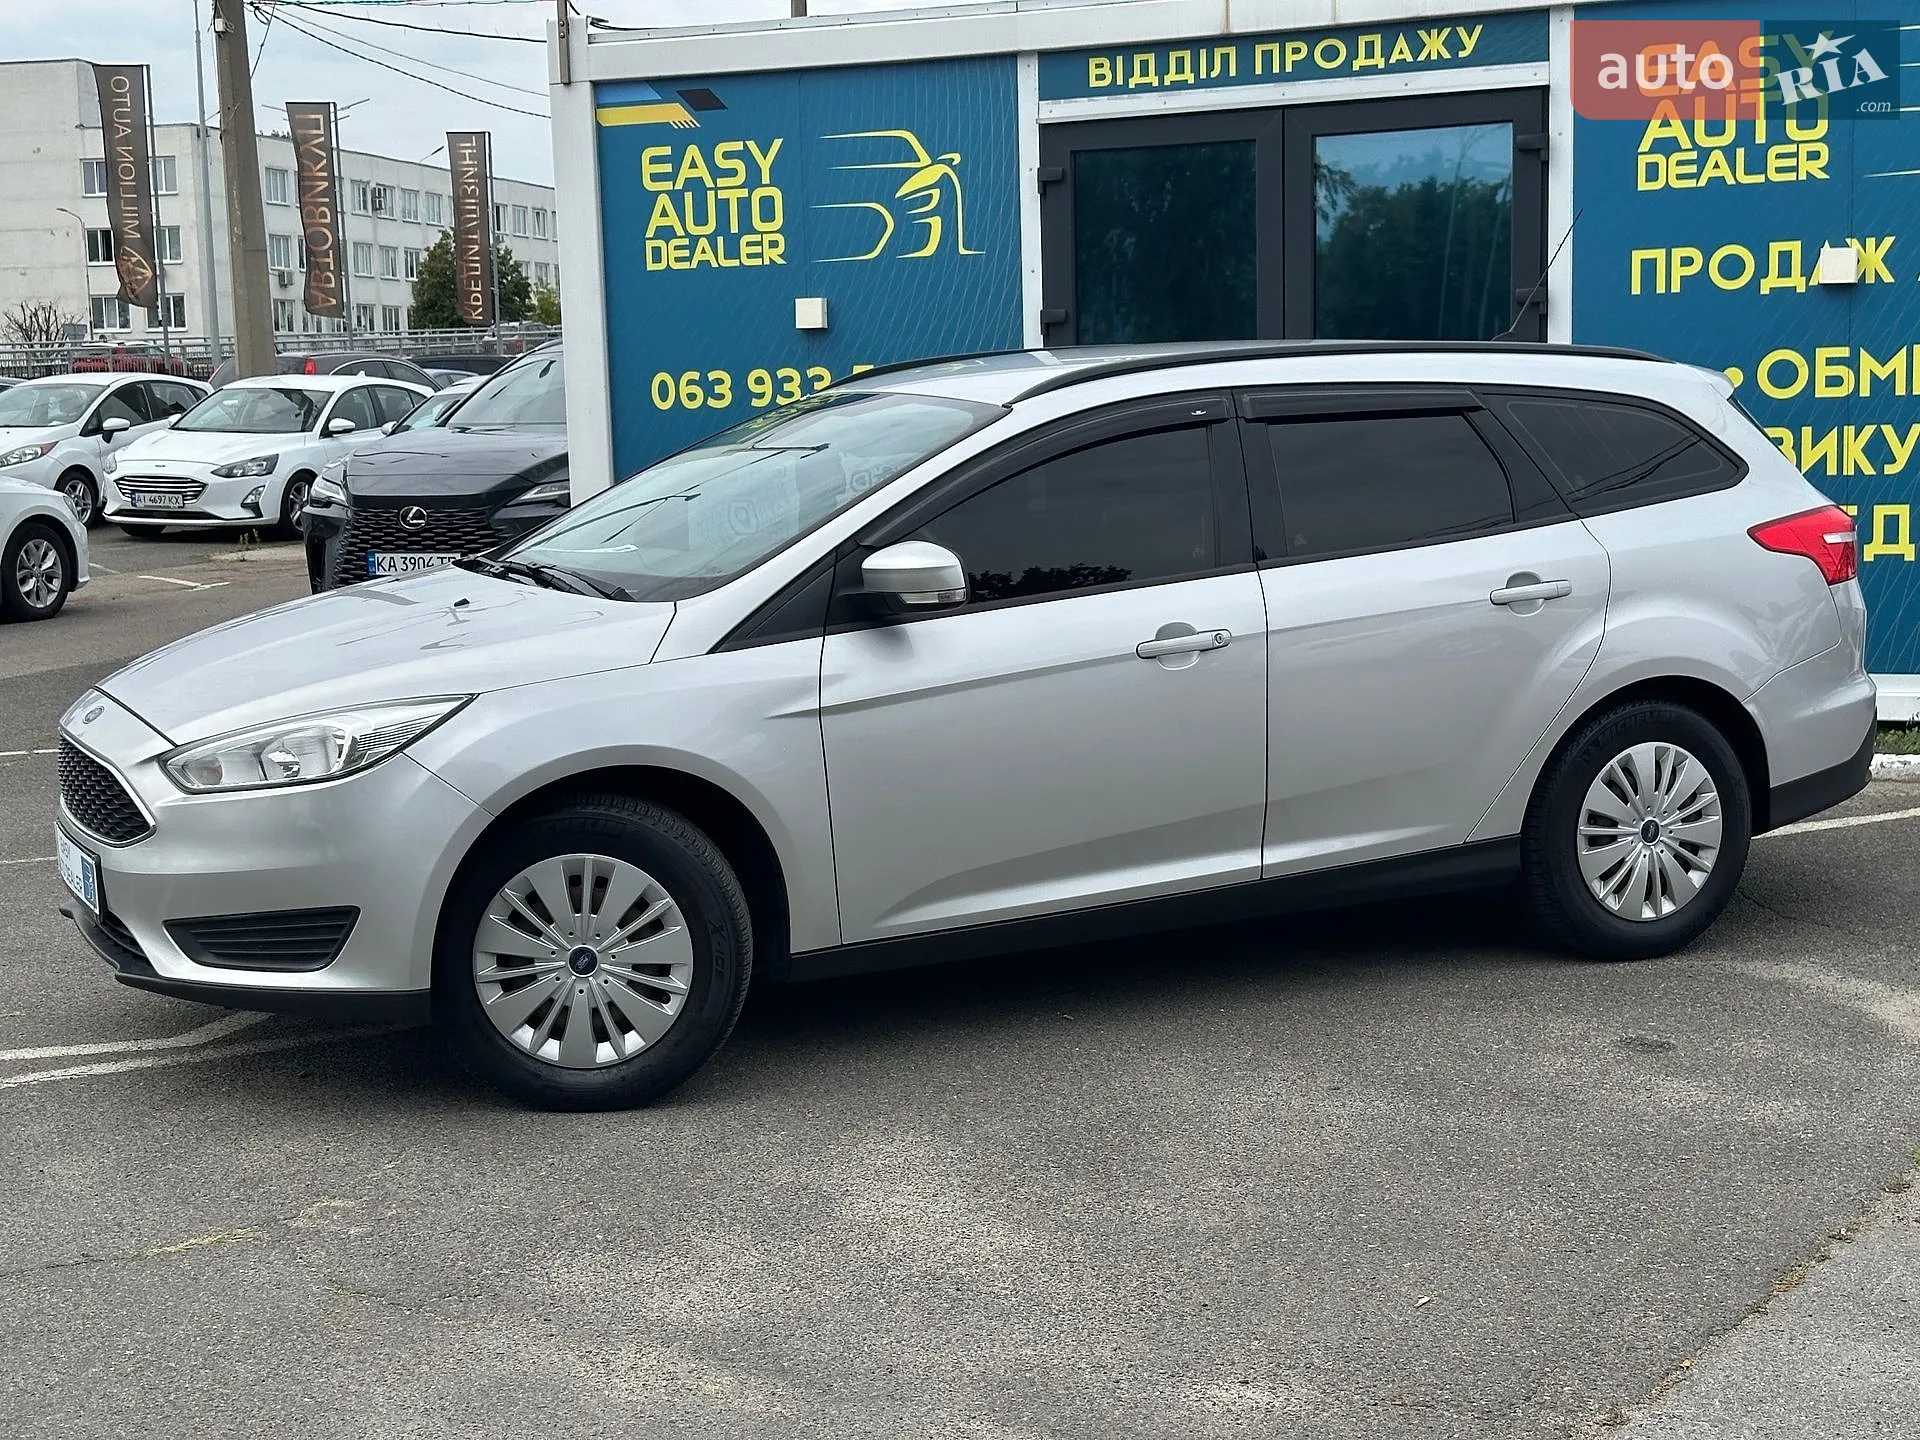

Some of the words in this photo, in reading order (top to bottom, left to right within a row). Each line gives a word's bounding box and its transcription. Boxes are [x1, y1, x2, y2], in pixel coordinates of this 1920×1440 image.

[1088, 46, 1237, 89] ВІДДІЛ
[1254, 24, 1483, 74] ПРОДАЖУ
[1637, 87, 1830, 153] AUTO
[641, 138, 784, 192] EASY
[1637, 142, 1831, 191] DEALER
[645, 186, 784, 238] AUTO
[645, 233, 787, 271] DEALER
[1631, 236, 1896, 295] ПРОДЖ
[651, 369, 733, 410] 063
[376, 556, 398, 572] KA
